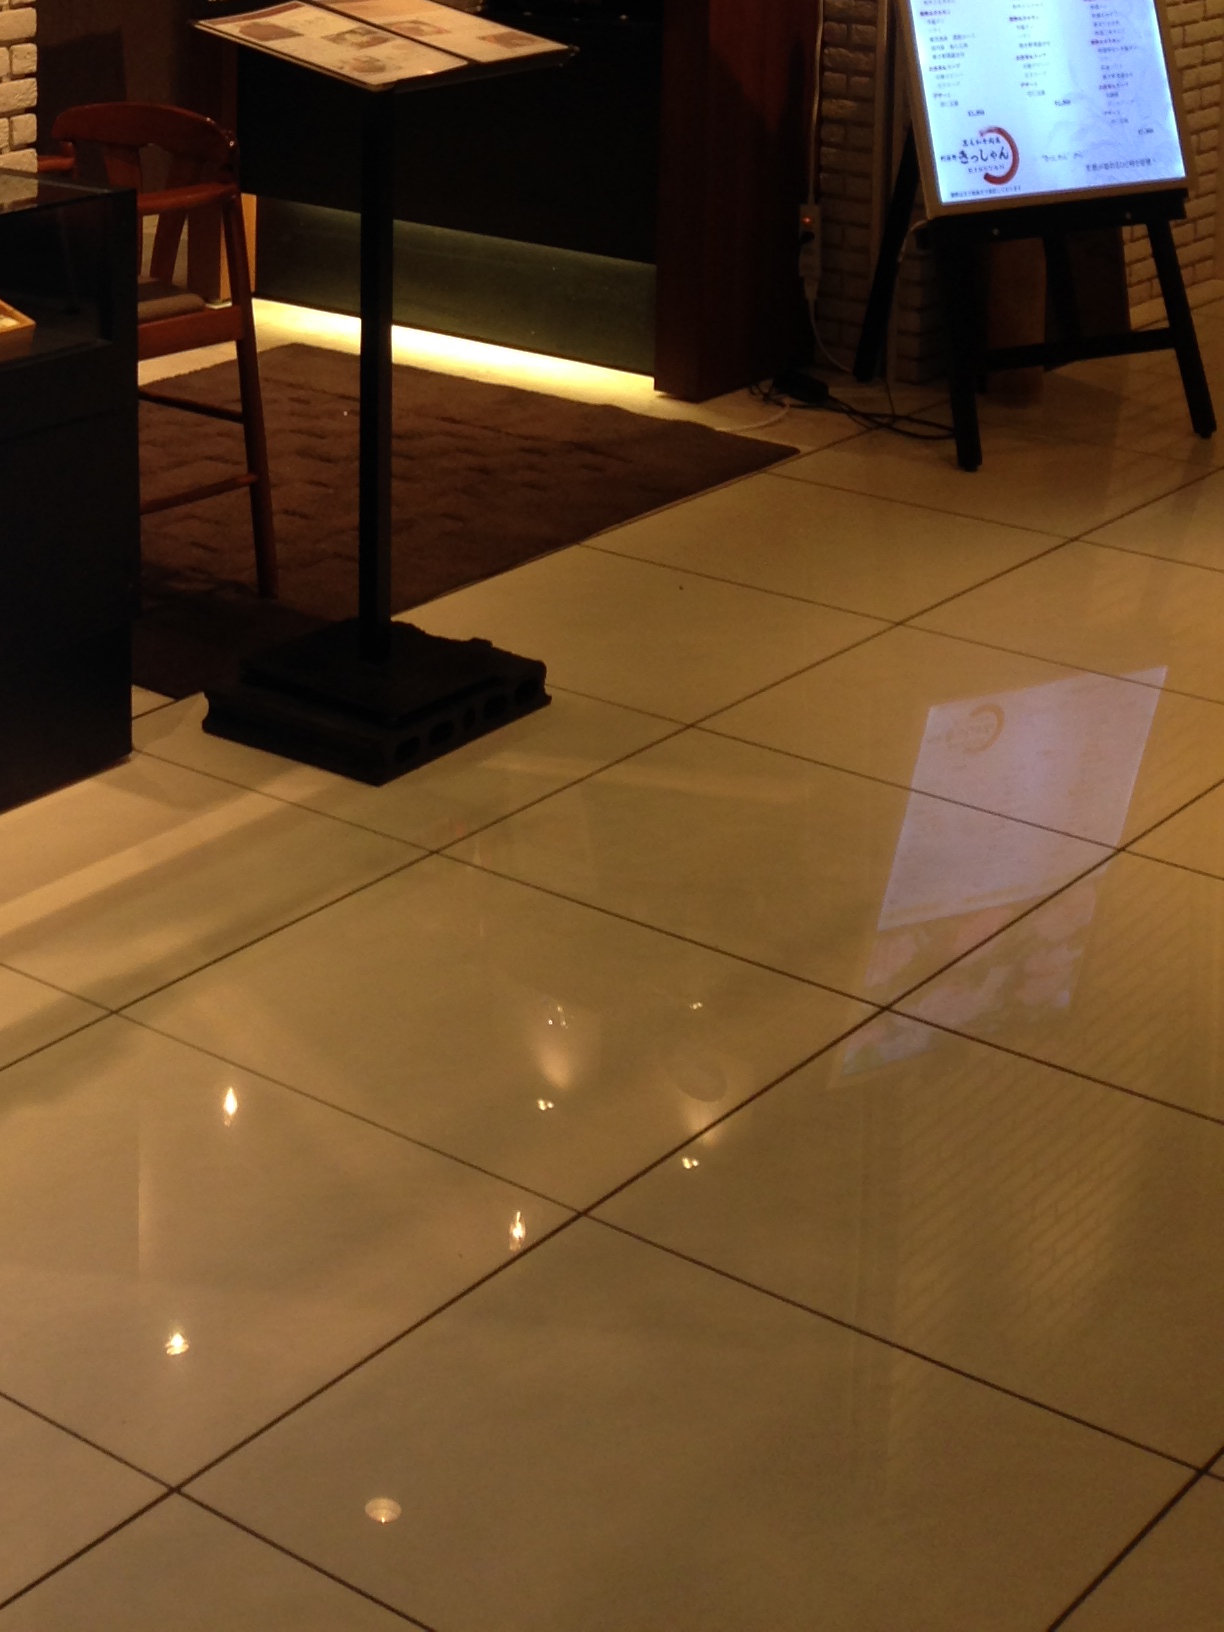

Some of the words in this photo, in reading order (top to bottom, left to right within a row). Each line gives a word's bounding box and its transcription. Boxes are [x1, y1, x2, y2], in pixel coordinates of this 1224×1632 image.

[959, 146, 1009, 165] きっしゃん
